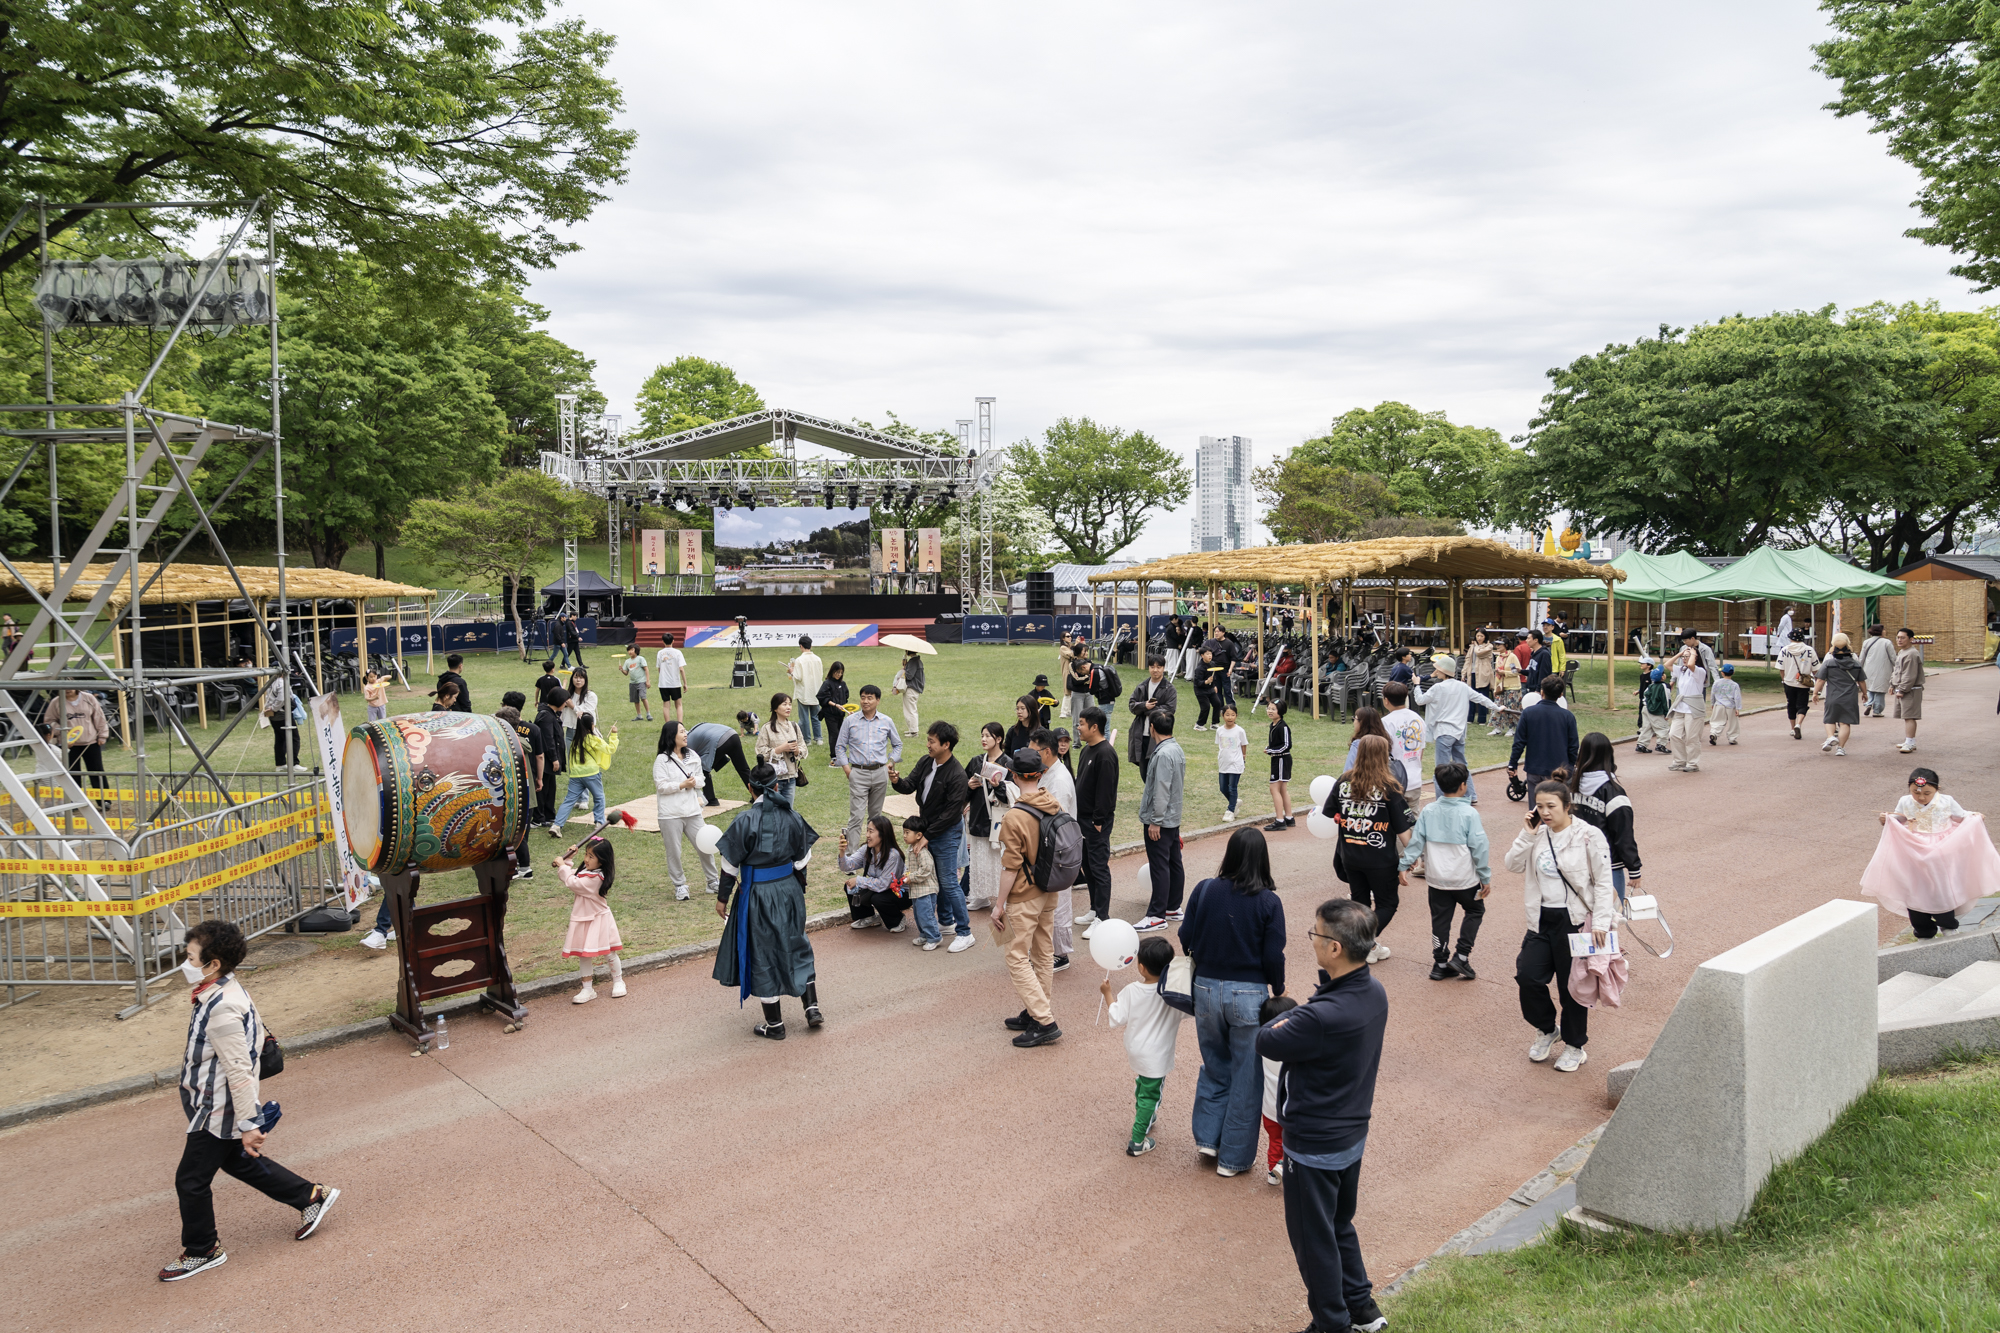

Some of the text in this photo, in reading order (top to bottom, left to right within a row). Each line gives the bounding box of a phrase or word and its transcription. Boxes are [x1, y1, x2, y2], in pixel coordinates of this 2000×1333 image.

[686, 538, 695, 560] 논개제
[890, 537, 899, 559] 논개제
[1342, 800, 1378, 817] FLOW
[100, 864, 114, 872] 위험
[119, 862, 145, 872] 출입금지
[154, 857, 165, 865] 위험
[168, 850, 189, 861] 출입금지
[198, 844, 208, 853] 위험
[210, 838, 229, 849] 출입금지
[236, 833, 245, 841] 위험
[246, 827, 263, 838] 출입금지
[269, 822, 278, 830] 위험
[279, 815, 295, 827] 출입금지
[300, 811, 308, 819] 위험
[310, 806, 324, 816] 출입지
[105, 903, 134, 912] 출입금지
[145, 898, 156, 907] 위험
[159, 889, 180, 902] 출입금지
[189, 882, 199, 891] 위험
[202, 874, 222, 887] 출입금지
[229, 869, 238, 877] 위험
[240, 861, 257, 873] 출입금지
[274, 849, 290, 860] 출입금지
[305, 838, 317, 848] 출입금
